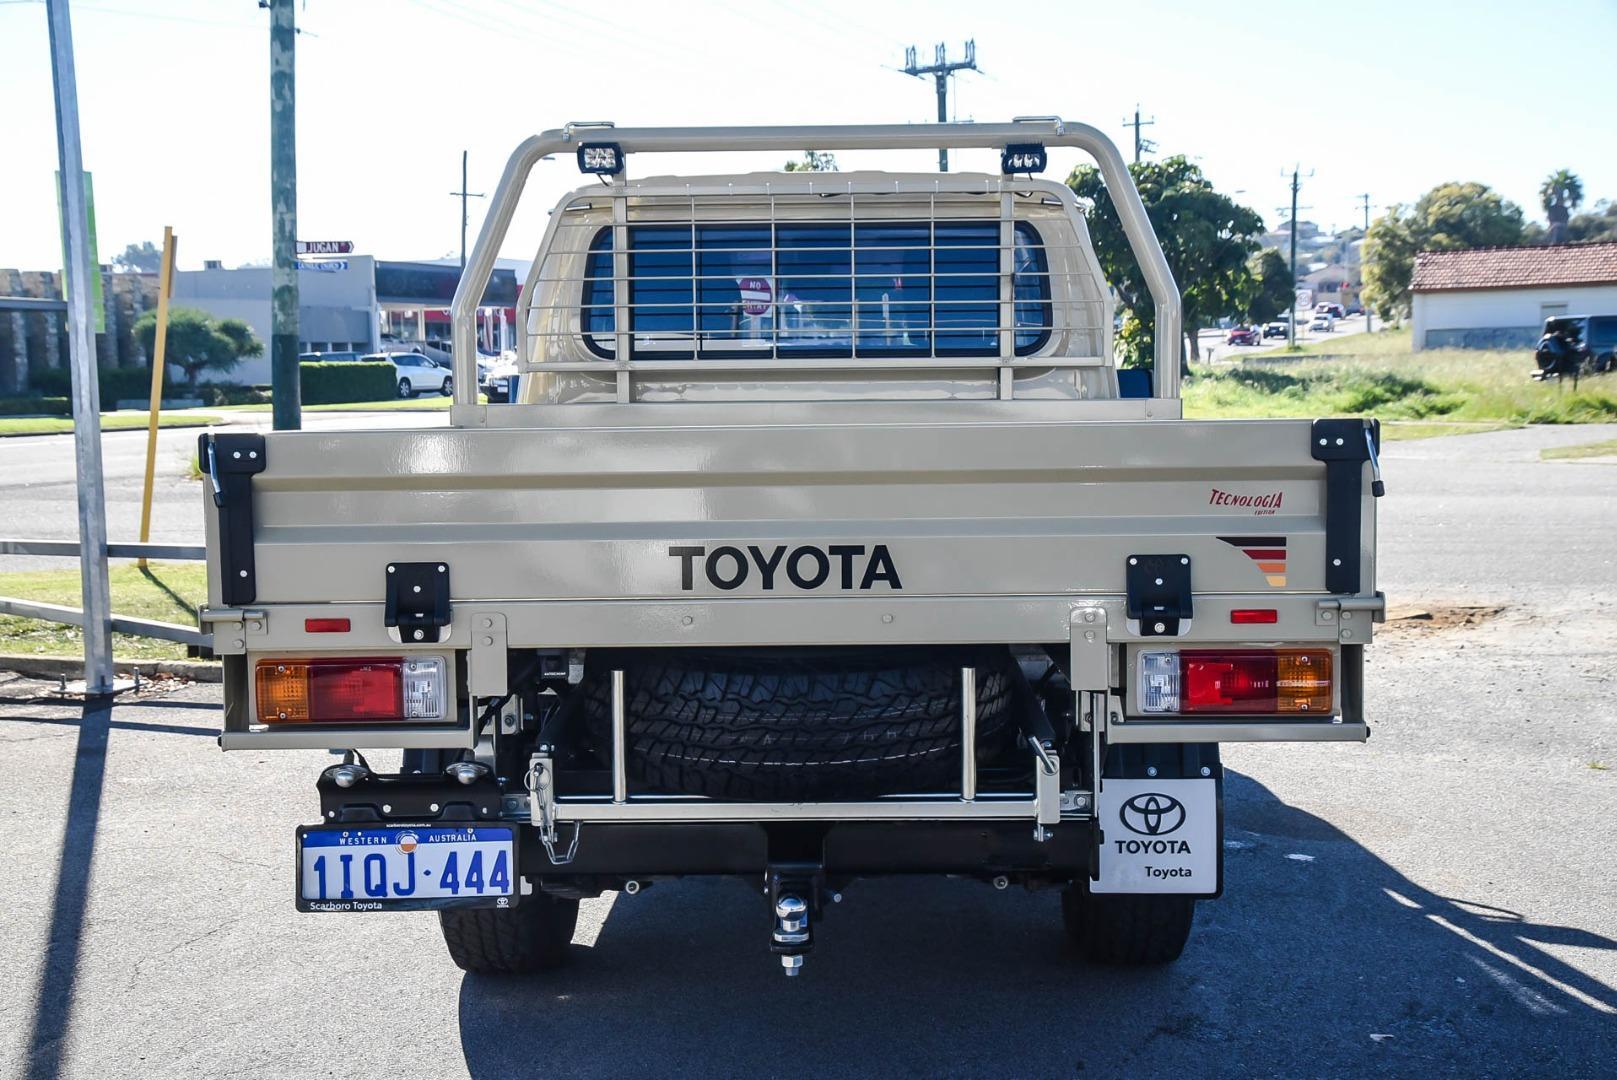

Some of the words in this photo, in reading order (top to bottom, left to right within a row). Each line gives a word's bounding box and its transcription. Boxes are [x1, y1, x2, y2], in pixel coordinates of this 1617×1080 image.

[308, 242, 338, 253] JUGAN
[749, 281, 761, 290] NO
[1209, 489, 1282, 508] TECNOLOGIA
[669, 544, 903, 590] TOYOTA
[339, 836, 387, 845] WESTERN
[429, 833, 477, 843] AUSTRALIA
[1114, 840, 1191, 854] TOYOTA
[1144, 866, 1192, 880] Toyota
[310, 901, 351, 910] Scarboro
[353, 901, 382, 910] Toyota
